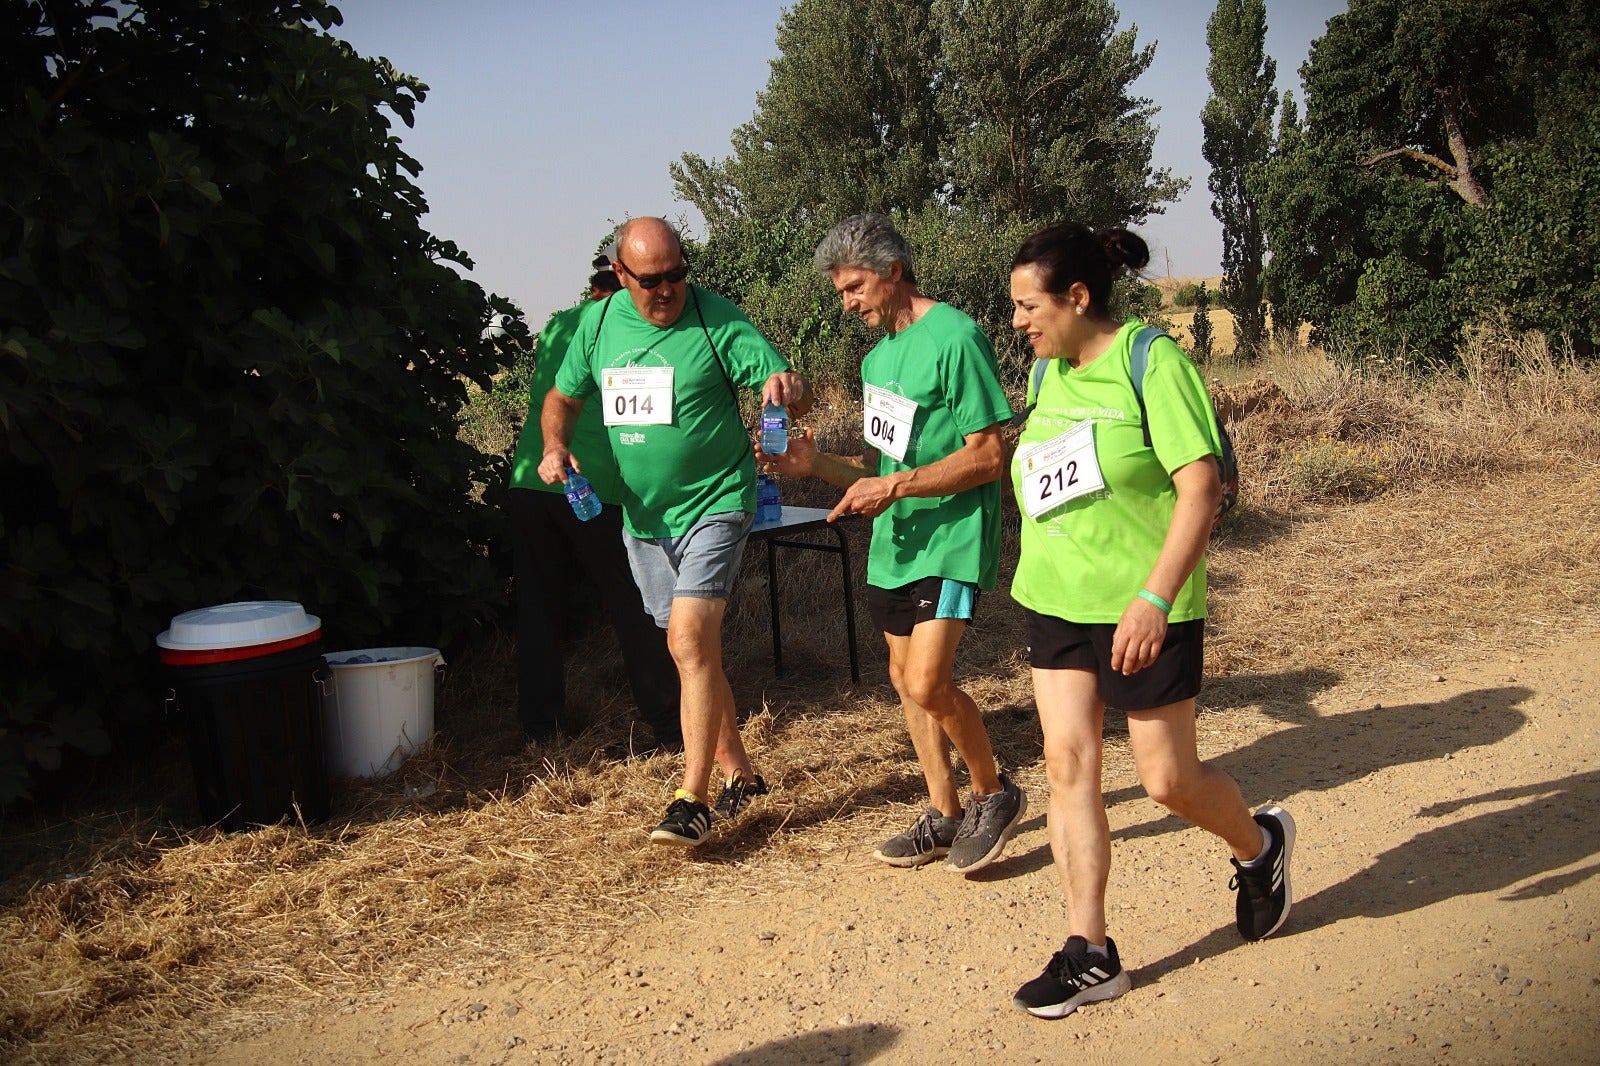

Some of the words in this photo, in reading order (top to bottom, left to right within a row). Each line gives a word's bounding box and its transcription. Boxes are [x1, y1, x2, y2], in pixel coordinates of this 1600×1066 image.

[615, 394, 654, 416] 014
[1098, 406, 1125, 421] VIDA
[871, 416, 895, 446] 004
[1039, 460, 1079, 501] 212
